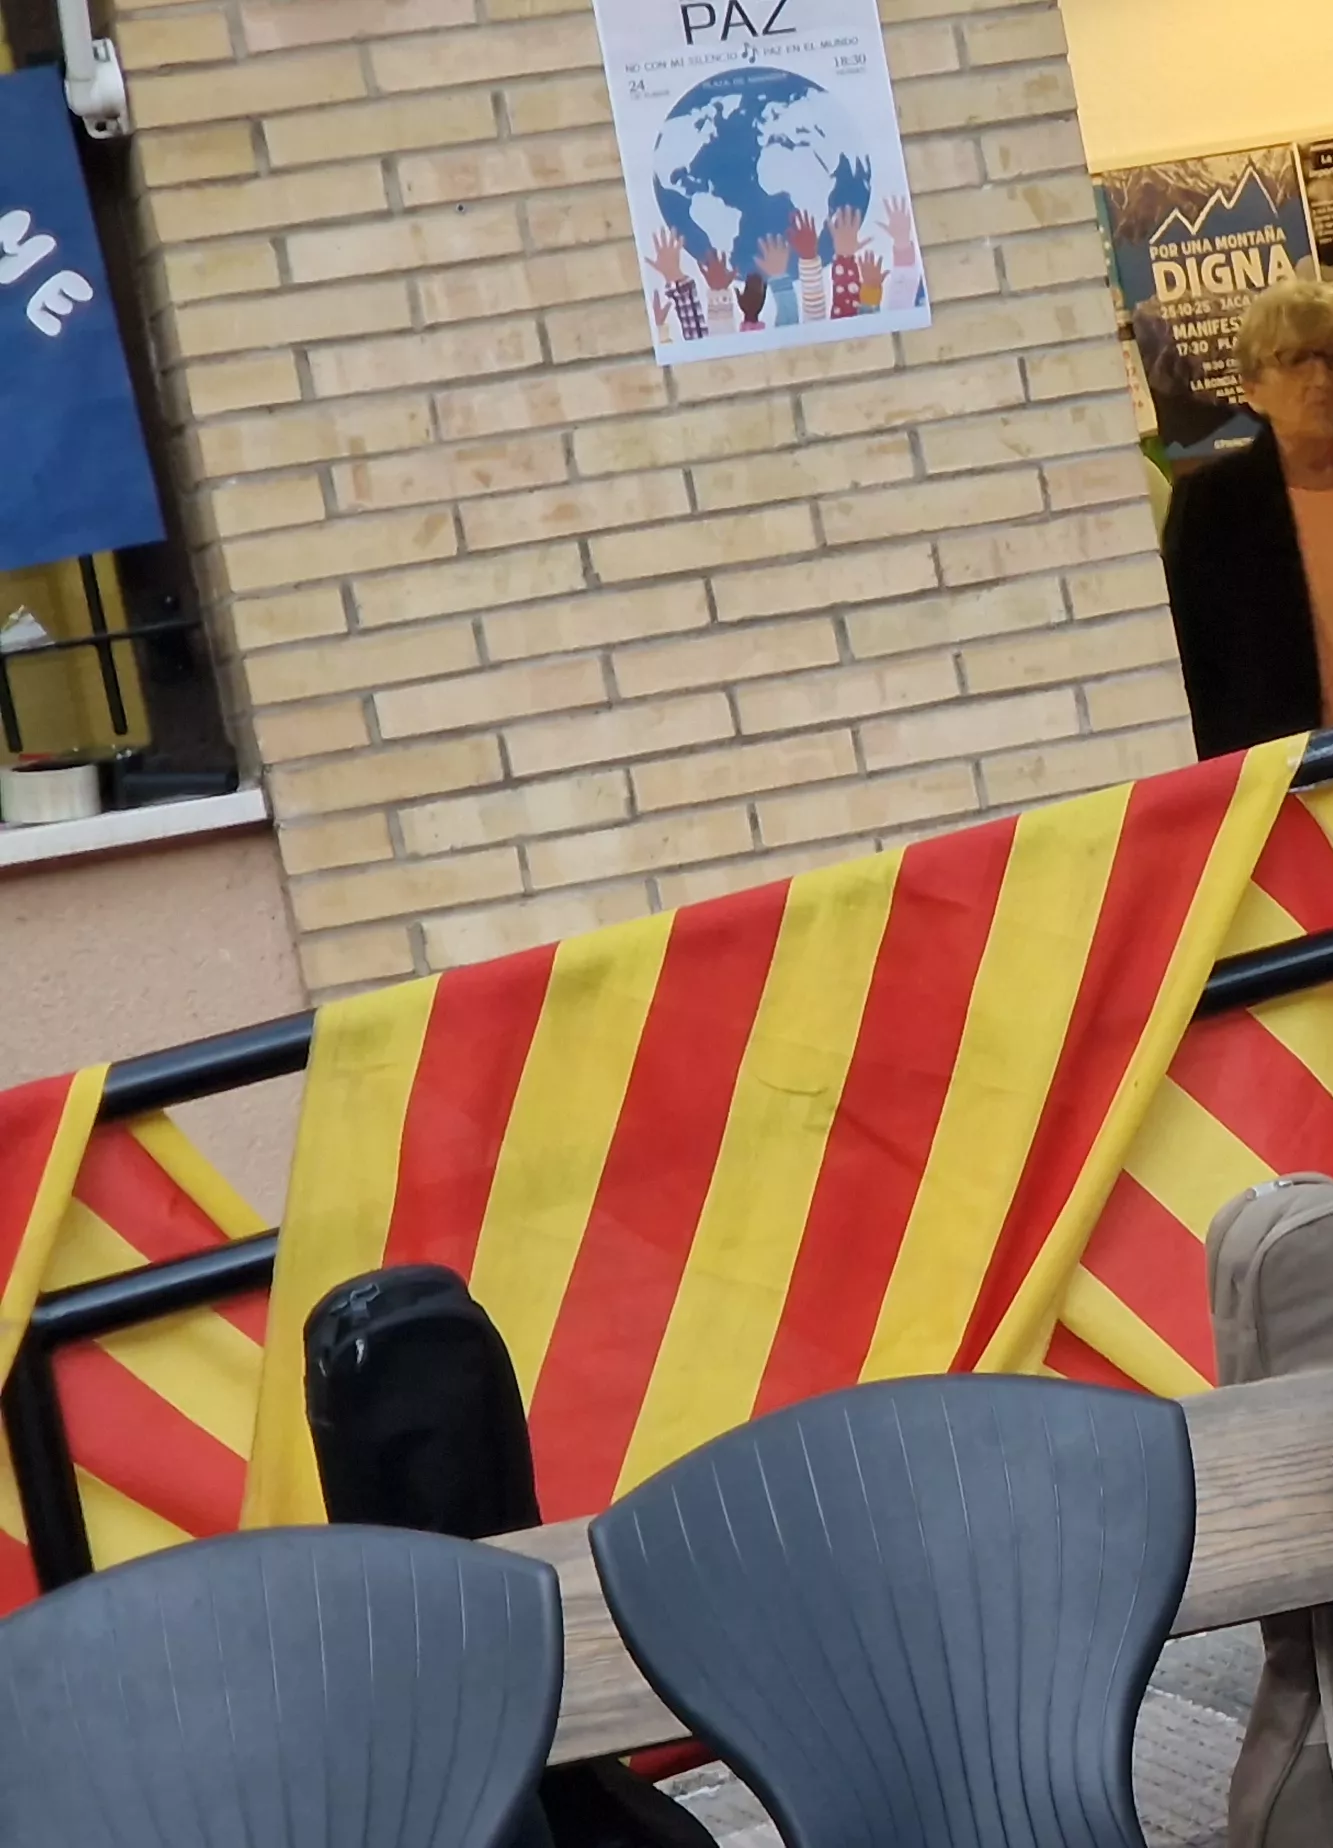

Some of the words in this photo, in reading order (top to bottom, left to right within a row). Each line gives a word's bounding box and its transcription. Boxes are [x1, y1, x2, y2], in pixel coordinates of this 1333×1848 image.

[681, 0, 797, 45] PAZ
[625, 62, 640, 73] NO
[644, 59, 667, 71] CON
[670, 56, 685, 68] MI
[688, 52, 738, 66] SILENCIO
[763, 44, 781, 55] PAZ
[786, 42, 801, 53] EN
[804, 41, 816, 51] EL
[819, 36, 859, 49] MUNDO
[833, 54, 867, 68] 18:30
[628, 79, 645, 92] 24
[1149, 242, 1179, 260] POR
[1181, 238, 1213, 256] UNA
[1215, 224, 1287, 251] MONTAÑA
[1152, 244, 1298, 302] DIGNA
[1172, 316, 1244, 340] MANIFES
